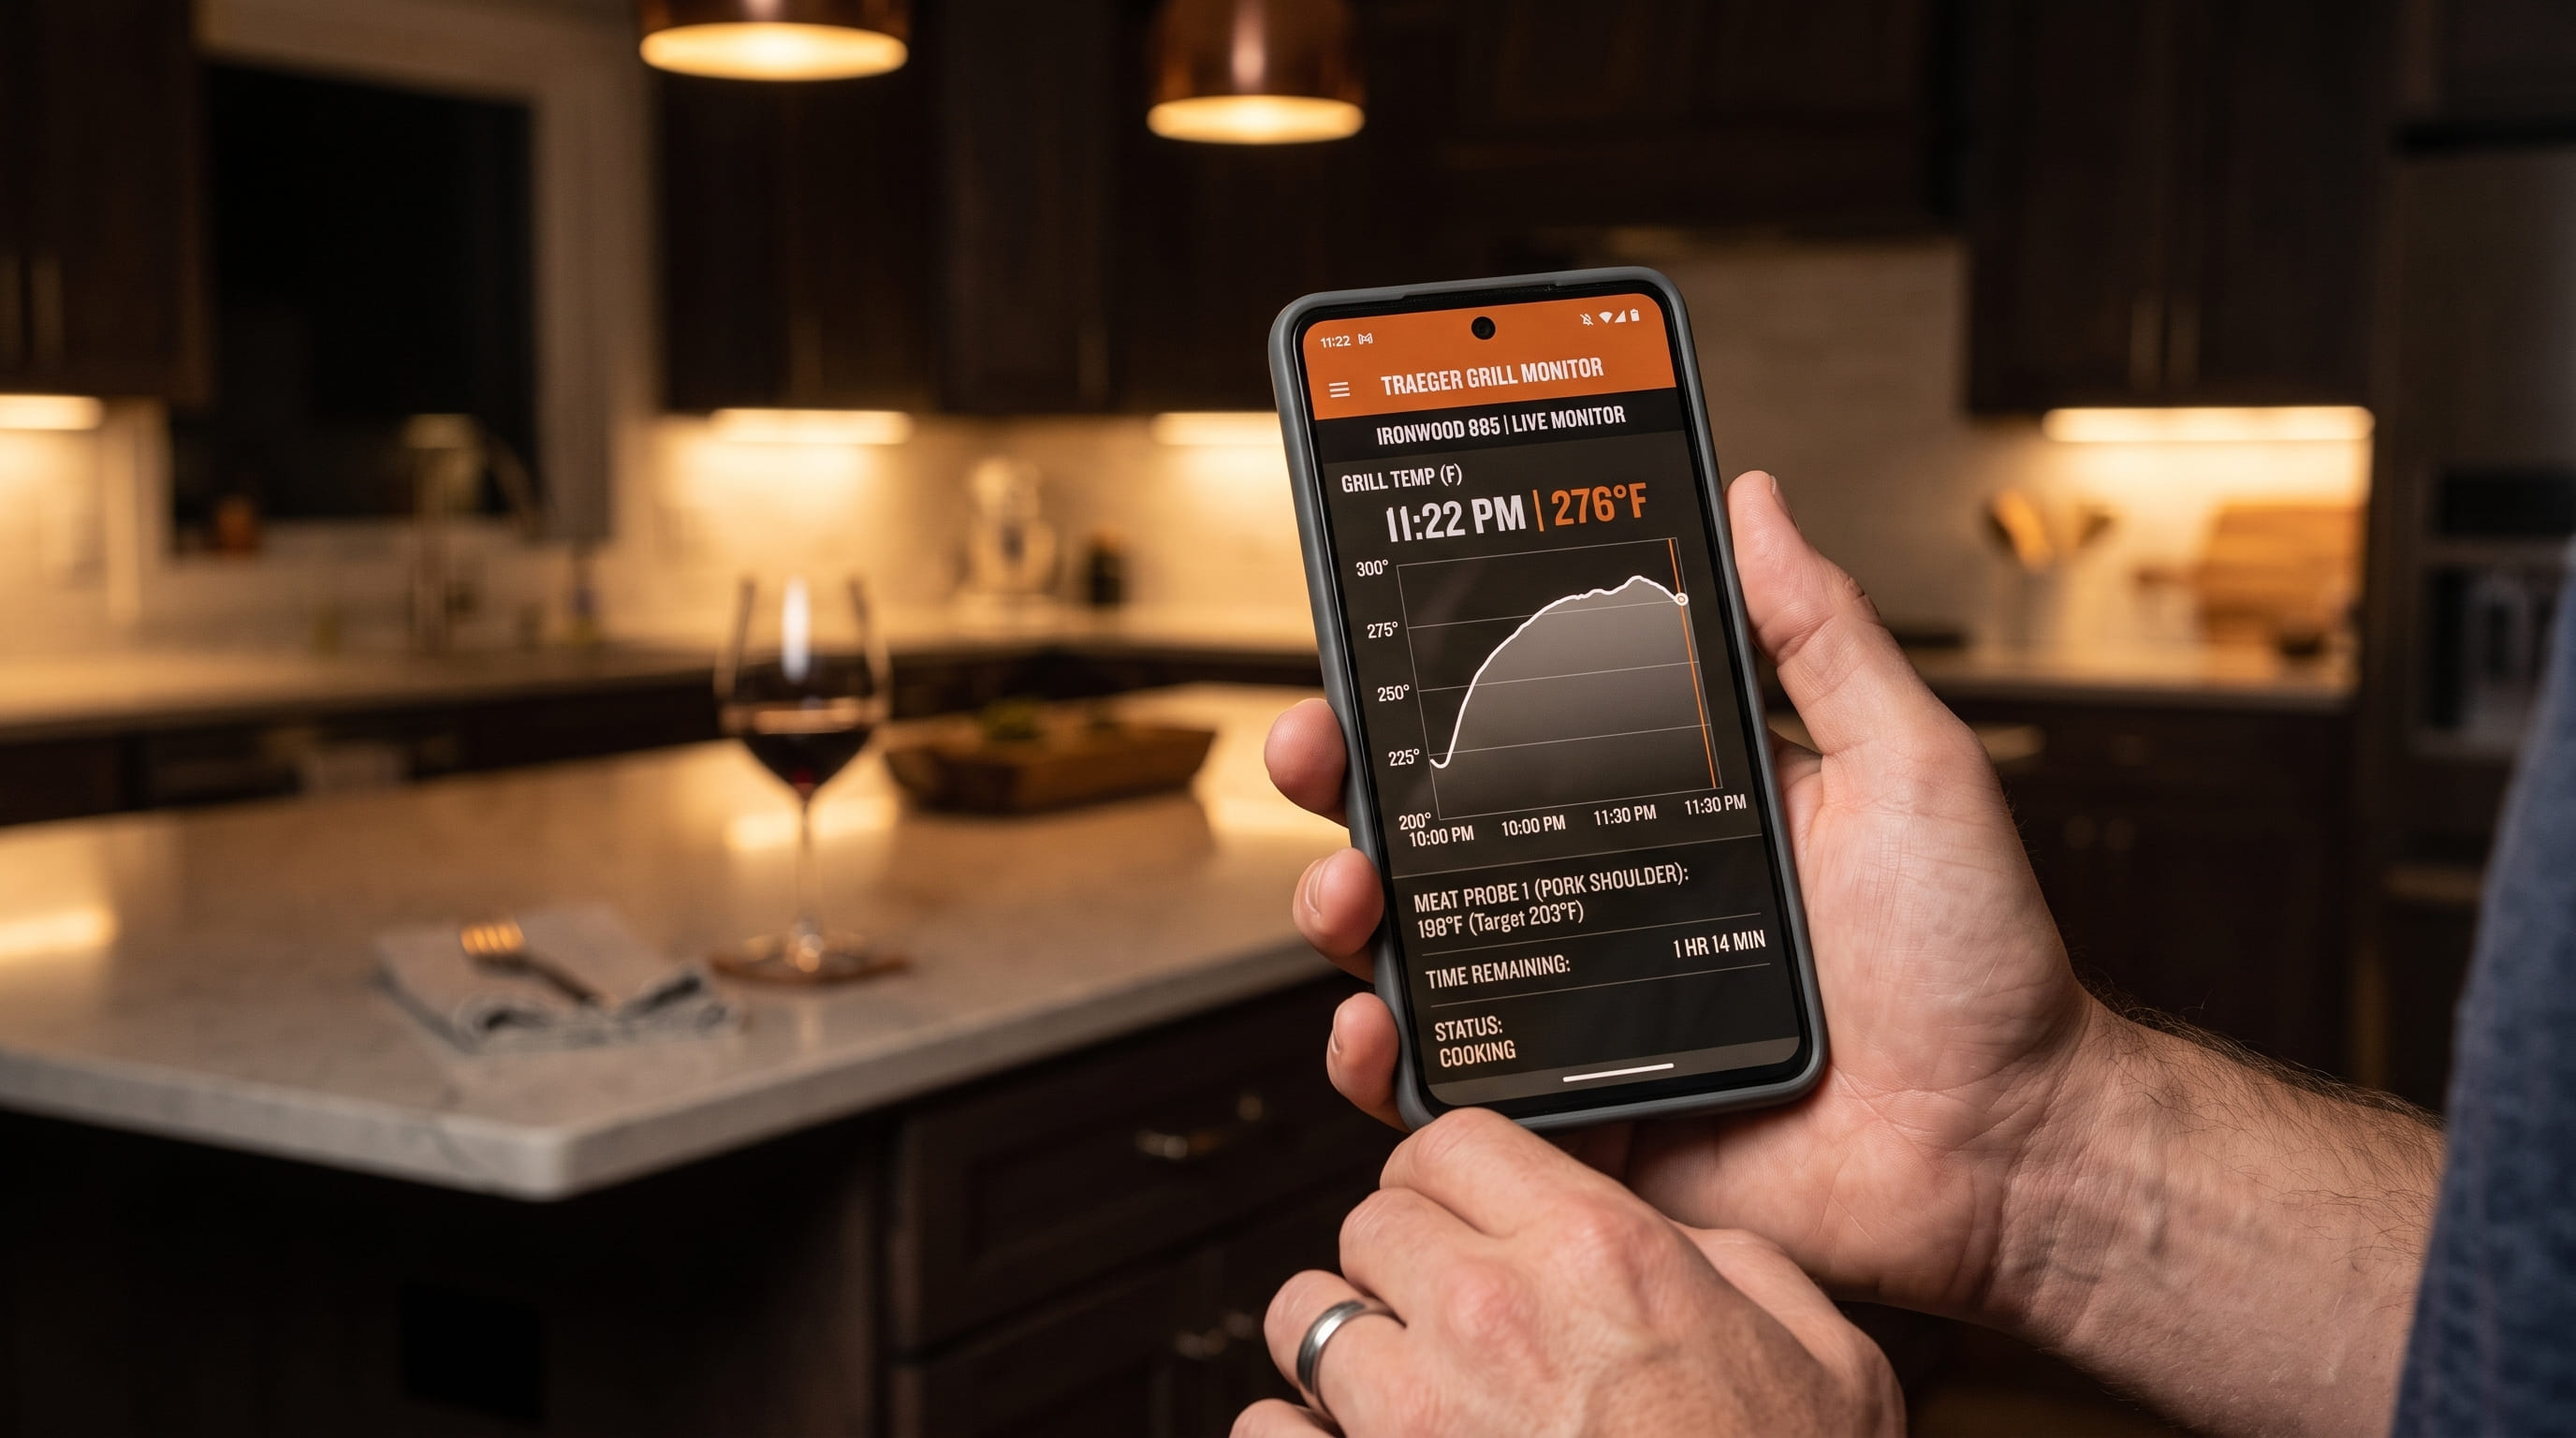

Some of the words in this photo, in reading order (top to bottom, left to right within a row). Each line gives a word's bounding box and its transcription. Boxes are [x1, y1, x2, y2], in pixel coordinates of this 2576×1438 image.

[1321, 335, 1351, 348] 11:22
[1381, 370, 1463, 396] TRAEGER
[1466, 365, 1517, 389] GRILL
[1521, 357, 1603, 383] MONITOR
[1376, 420, 1465, 446] IRONWOOD
[1469, 417, 1500, 436] 885
[1512, 413, 1548, 433] LIVE
[1551, 405, 1626, 429] MONITOR
[1341, 473, 1388, 492] GRILL
[1390, 468, 1435, 488] TEMP
[1440, 463, 1462, 487] (F)
[1385, 502, 1466, 542] 11:22
[1471, 495, 1526, 534] PM
[1551, 483, 1647, 526] 276°F
[1355, 559, 1389, 577] 300°
[1367, 622, 1398, 638] 275°
[1377, 684, 1410, 702] 250°
[1388, 749, 1420, 766] 225°
[1593, 808, 1631, 826] 11:30
[1632, 805, 1657, 822] PM
[1685, 798, 1722, 815] 11:30
[1724, 795, 1747, 811] PM
[1398, 813, 1431, 830] 200°
[1501, 818, 1540, 836] 10:00
[1542, 815, 1566, 832] PM
[1409, 829, 1449, 847] 10:00
[1451, 826, 1474, 844] PM
[1414, 890, 1458, 913] MEAT
[1464, 883, 1519, 907] PROBE
[1522, 882, 1530, 900] 1
[1535, 876, 1587, 902] (PORK
[1589, 862, 1689, 891] SHOULDER):
[1417, 916, 1463, 939] 198°F
[1469, 910, 1525, 936] (Target
[1529, 901, 1584, 926] 203°F)
[1674, 940, 1681, 958] 1
[1685, 937, 1709, 957] HR
[1712, 934, 1731, 954] 14
[1733, 930, 1766, 950] MIN
[1426, 967, 1468, 989] TIME
[1472, 955, 1571, 984] REMAINING:
[1434, 1016, 1503, 1041] STATUS:
[1440, 1040, 1516, 1068] COOKING
